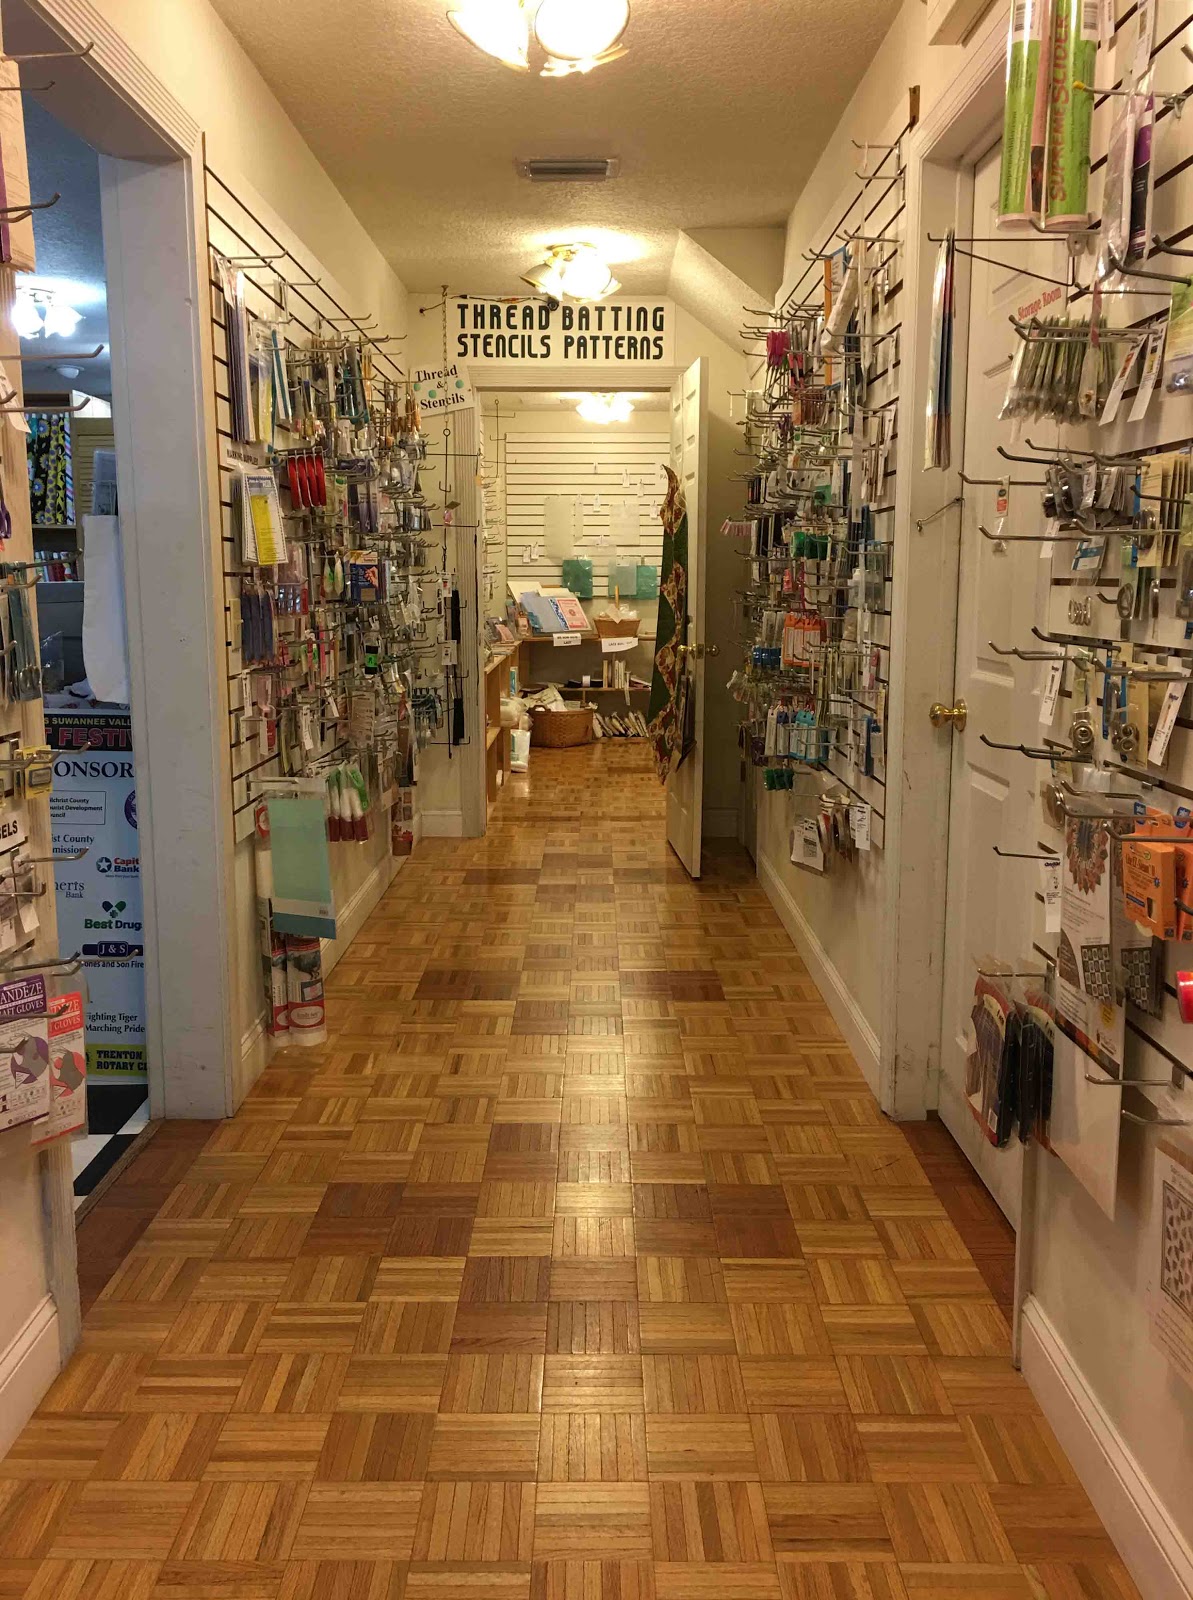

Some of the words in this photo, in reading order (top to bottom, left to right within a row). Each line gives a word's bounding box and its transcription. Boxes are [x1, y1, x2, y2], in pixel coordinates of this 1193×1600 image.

[457, 304, 550, 330] THREAD
[562, 306, 664, 331] BATTING
[457, 333, 551, 358] STENCILS
[564, 335, 664, 360] PATTERNS
[414, 365, 458, 382] Thread
[436, 380, 443, 389] &
[420, 393, 465, 410] Stencils
[52, 717, 106, 726] SUWANNEE
[54, 760, 134, 778] ONSOR
[69, 797, 90, 805] County
[0, 819, 18, 839] ELS
[63, 834, 95, 844] County
[114, 865, 140, 873] Bank
[84, 918, 113, 929] Best
[115, 920, 142, 931] Drug
[100, 944, 105, 954] J
[108, 944, 117, 954] &
[119, 944, 126, 954] S
[102, 960, 115, 968] and
[131, 960, 144, 968] Fire
[0, 982, 43, 1004] ANDEZE
[0, 1006, 15, 1017] AFT
[16, 1000, 44, 1014] GLOVES
[54, 1015, 81, 1030] GLOVES
[118, 1012, 138, 1023] Tiger
[85, 1024, 122, 1034] Marching
[124, 1024, 145, 1032] Pride
[96, 1050, 143, 1060] TRENTON
[96, 1061, 134, 1070] ROTARY
